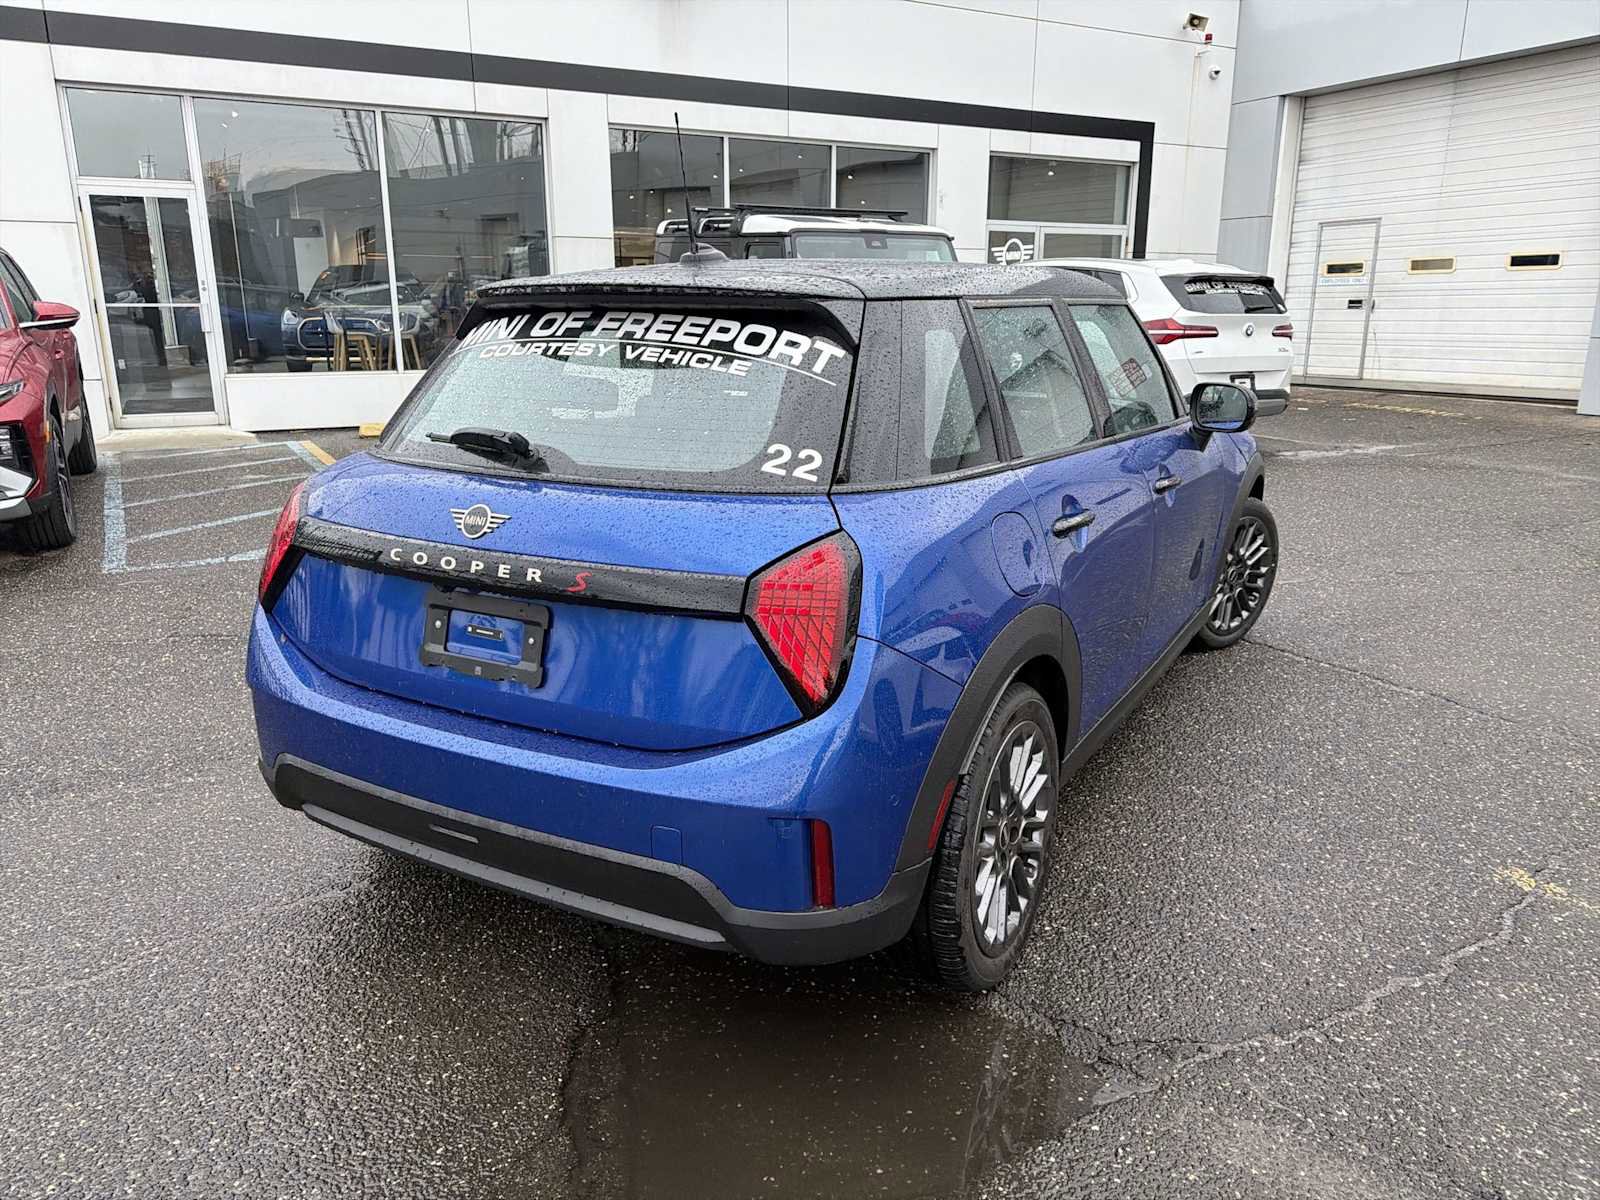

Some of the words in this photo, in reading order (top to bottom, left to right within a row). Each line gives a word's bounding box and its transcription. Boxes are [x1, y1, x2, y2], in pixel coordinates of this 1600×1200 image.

[1184, 281, 1211, 292] BMW
[455, 314, 531, 352] MINI
[530, 311, 593, 338] OF
[591, 311, 847, 374] FREEPORT
[479, 342, 618, 359] COURTESY
[625, 344, 752, 377] VEHICLE
[761, 443, 823, 482] 22
[464, 515, 487, 527] MINI
[390, 548, 542, 583] COOPER
[566, 571, 592, 592] S
